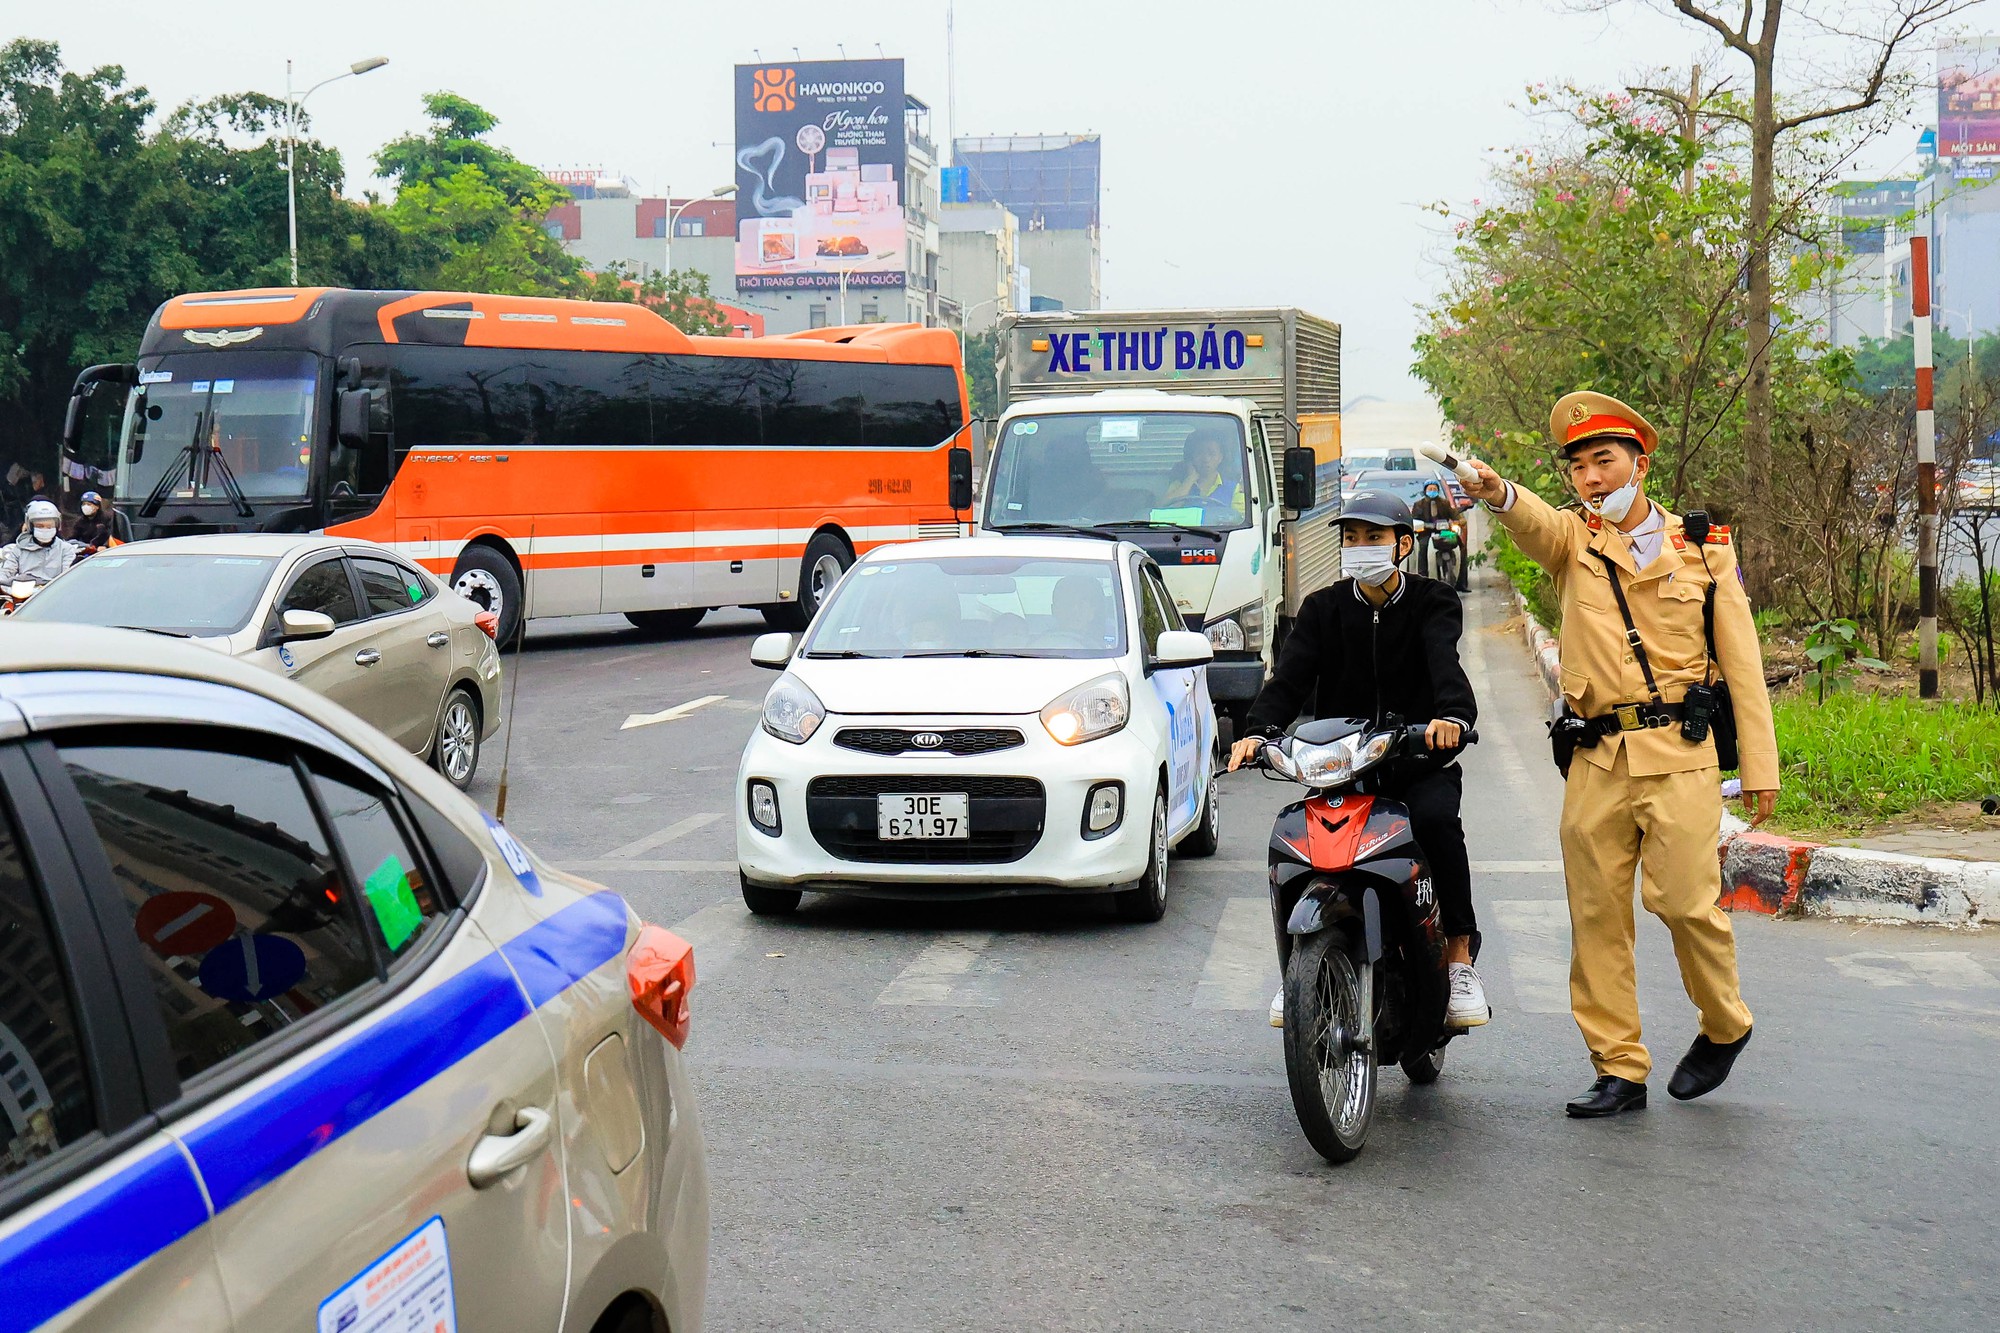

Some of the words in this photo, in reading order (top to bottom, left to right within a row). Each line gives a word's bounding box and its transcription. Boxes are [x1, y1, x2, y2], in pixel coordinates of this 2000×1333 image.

[800, 81, 884, 96] HAWONKOO
[865, 130, 884, 138] THAN
[763, 276, 794, 287] TRANG
[797, 275, 814, 286] GIA
[1048, 332, 1091, 372] XE
[1097, 327, 1169, 372] THƯ
[1174, 323, 1245, 371] BÁO
[916, 735, 938, 745] KIA
[904, 797, 941, 815] 30E
[889, 818, 958, 836] 621.97
